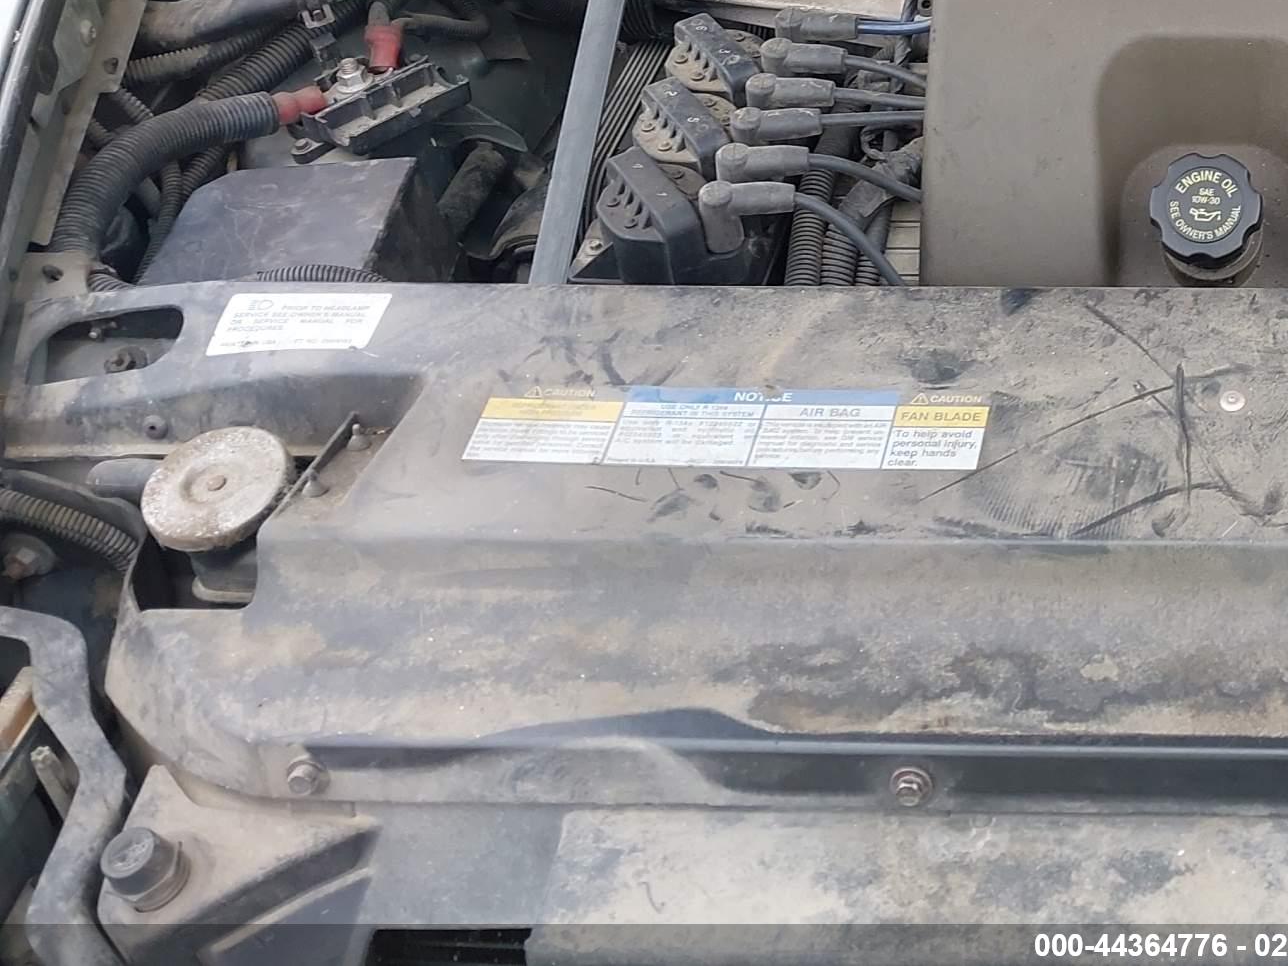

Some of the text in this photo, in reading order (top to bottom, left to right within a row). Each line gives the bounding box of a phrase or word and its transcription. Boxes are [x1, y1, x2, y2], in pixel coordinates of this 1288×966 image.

[1175, 170, 1239, 198] ENGINE OIL
[1199, 188, 1214, 196] SAE
[1191, 196, 1221, 205] 10W-30
[1169, 200, 1241, 240] SEE OWNER'S MANUAL
[543, 389, 597, 398] CAUTION
[929, 394, 984, 404] CAUTION
[800, 408, 862, 418] AIR BAG
[900, 412, 982, 422] FAN BLADE
[895, 429, 973, 441] To help avoid
[892, 439, 977, 450] personal injury,
[889, 448, 956, 459] keep hands
[887, 458, 918, 467] clear.
